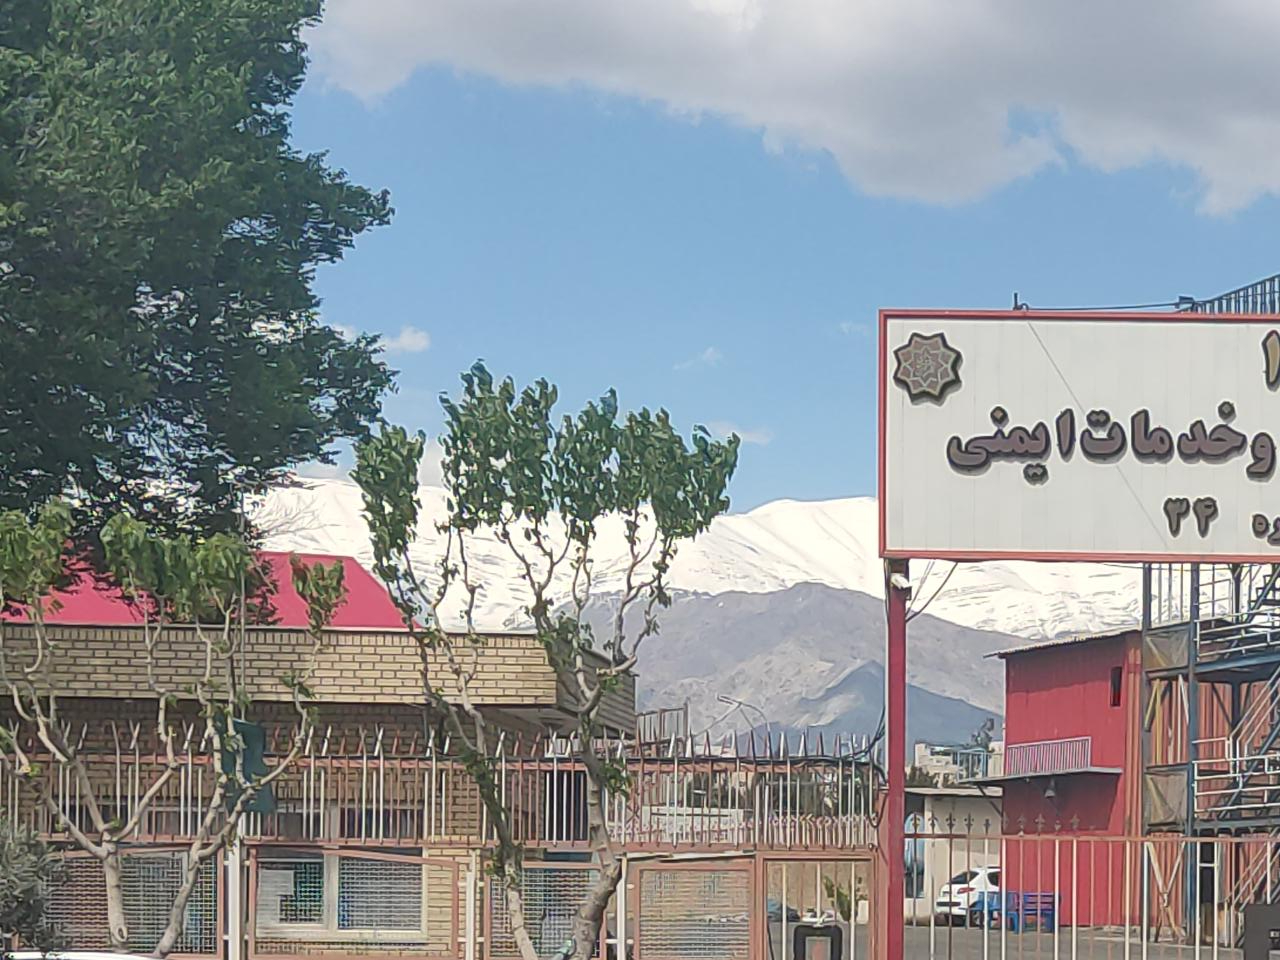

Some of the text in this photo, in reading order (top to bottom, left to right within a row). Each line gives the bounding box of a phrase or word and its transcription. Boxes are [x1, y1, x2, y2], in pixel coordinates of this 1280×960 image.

[947, 406, 1076, 485] ایمنی
[1080, 401, 1247, 464] خدمات
[1246, 432, 1276, 482] و
